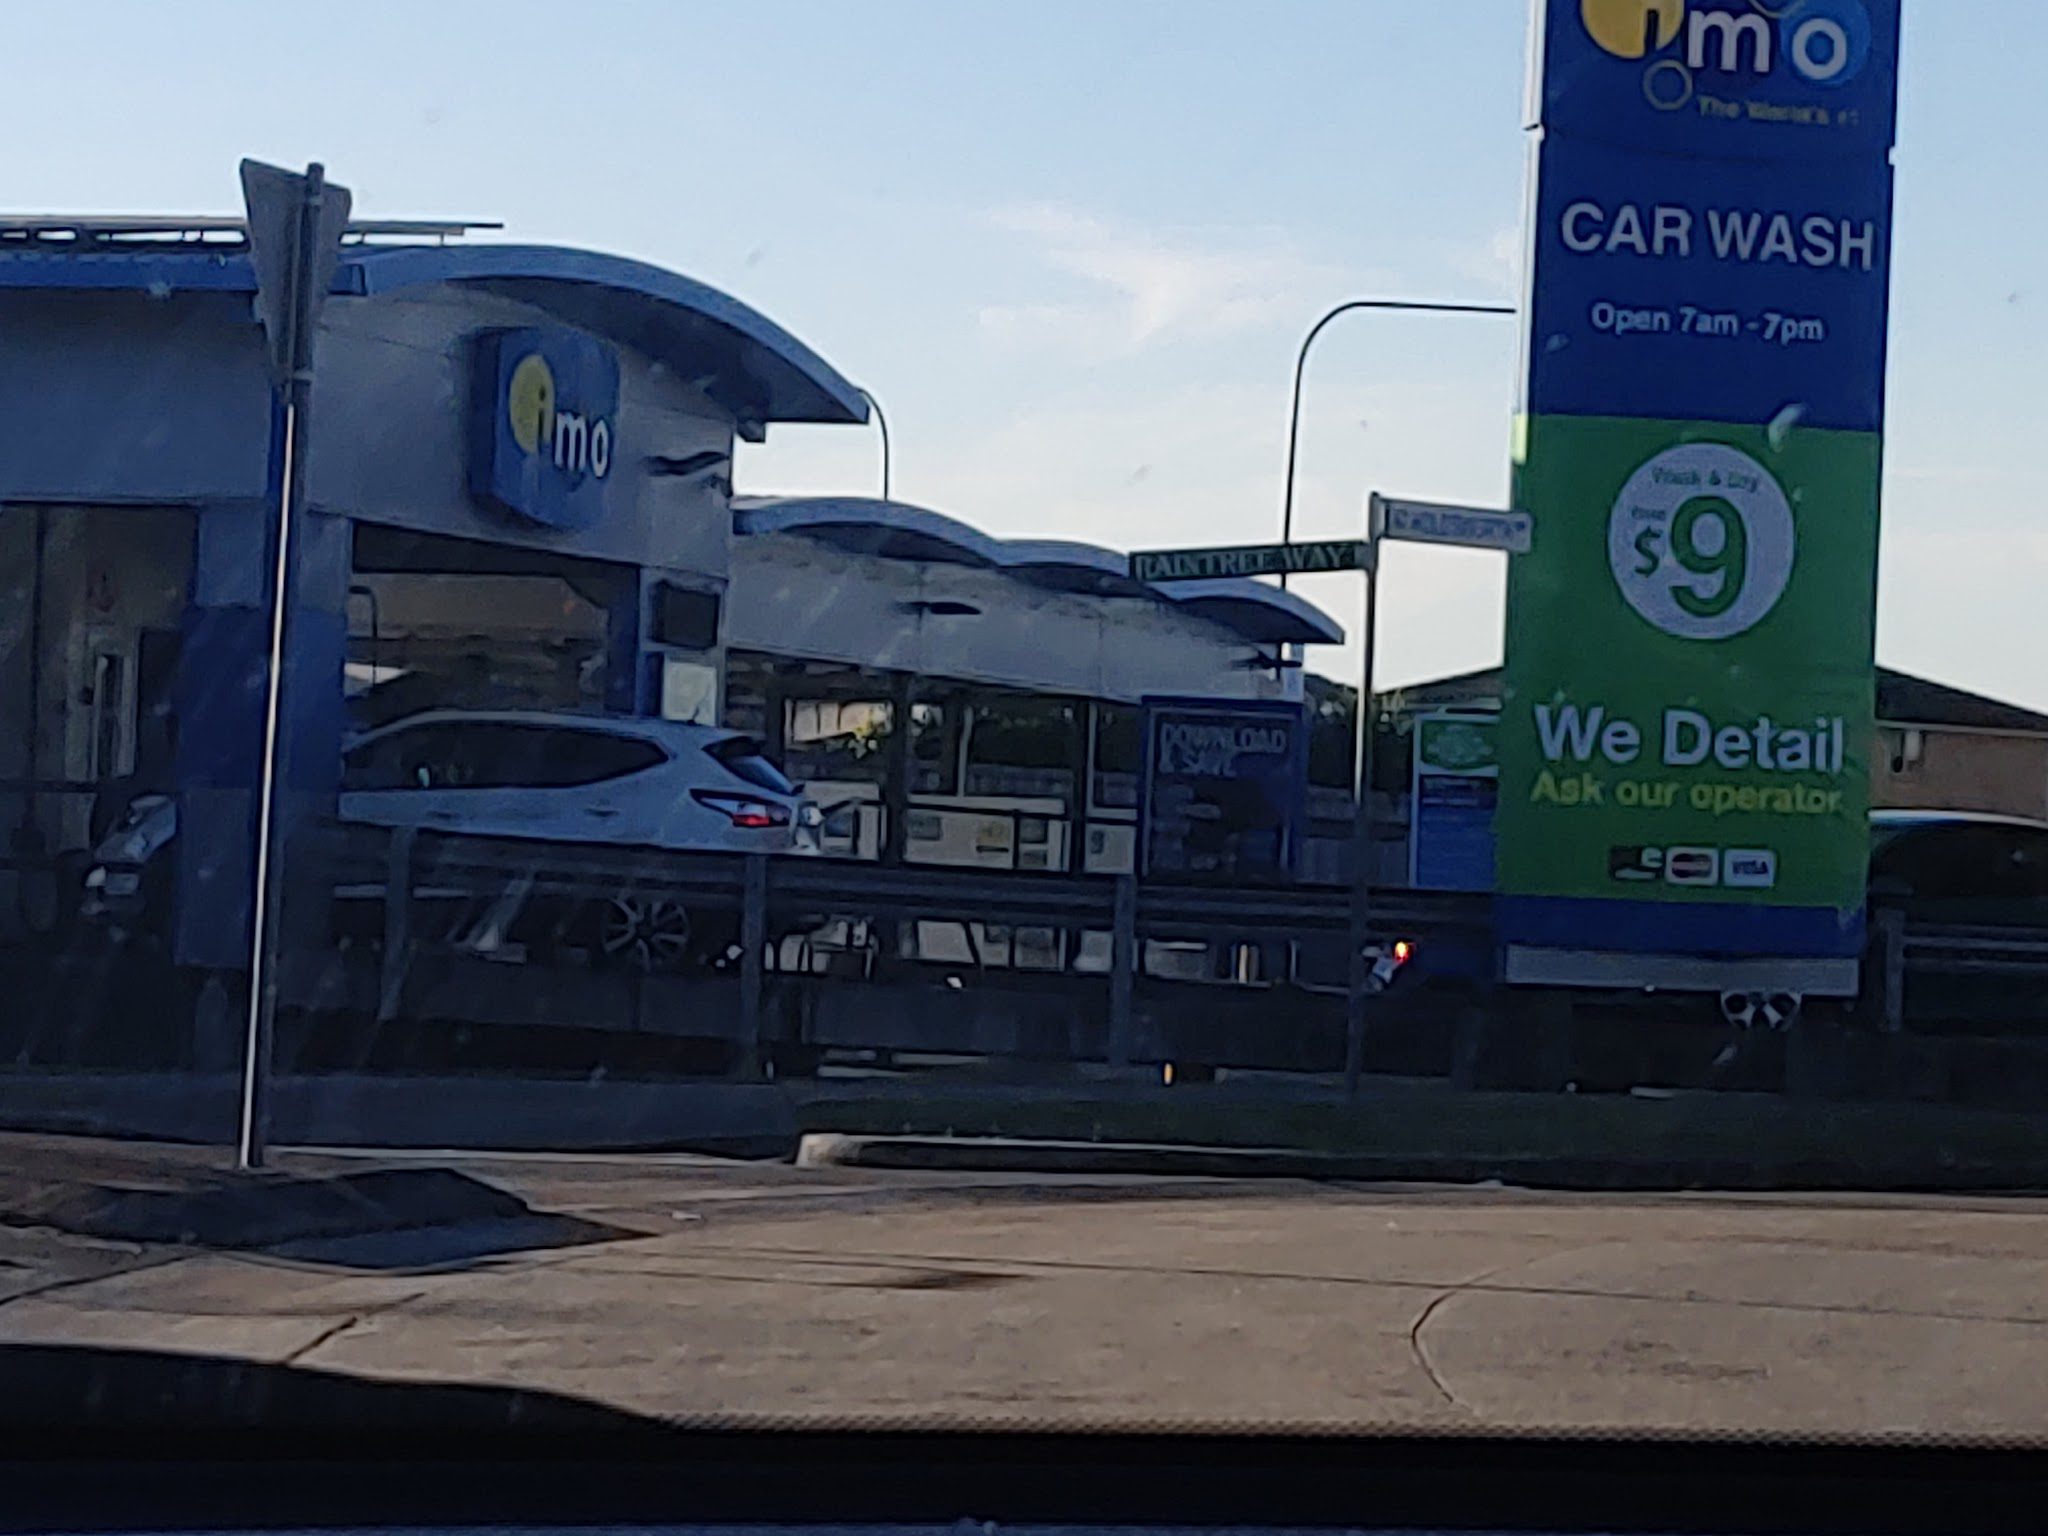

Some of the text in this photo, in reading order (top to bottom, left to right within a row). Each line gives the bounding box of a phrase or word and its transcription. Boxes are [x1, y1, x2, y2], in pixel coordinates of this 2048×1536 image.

[1561, 202, 1874, 271] CAR WASH
[1591, 302, 1670, 336] Open
[537, 384, 609, 478] imo
[1282, 545, 1344, 570] WAY
[1534, 703, 1640, 764] We
[1663, 708, 1843, 773] Detail
[1531, 771, 1841, 817] Ask our operator
